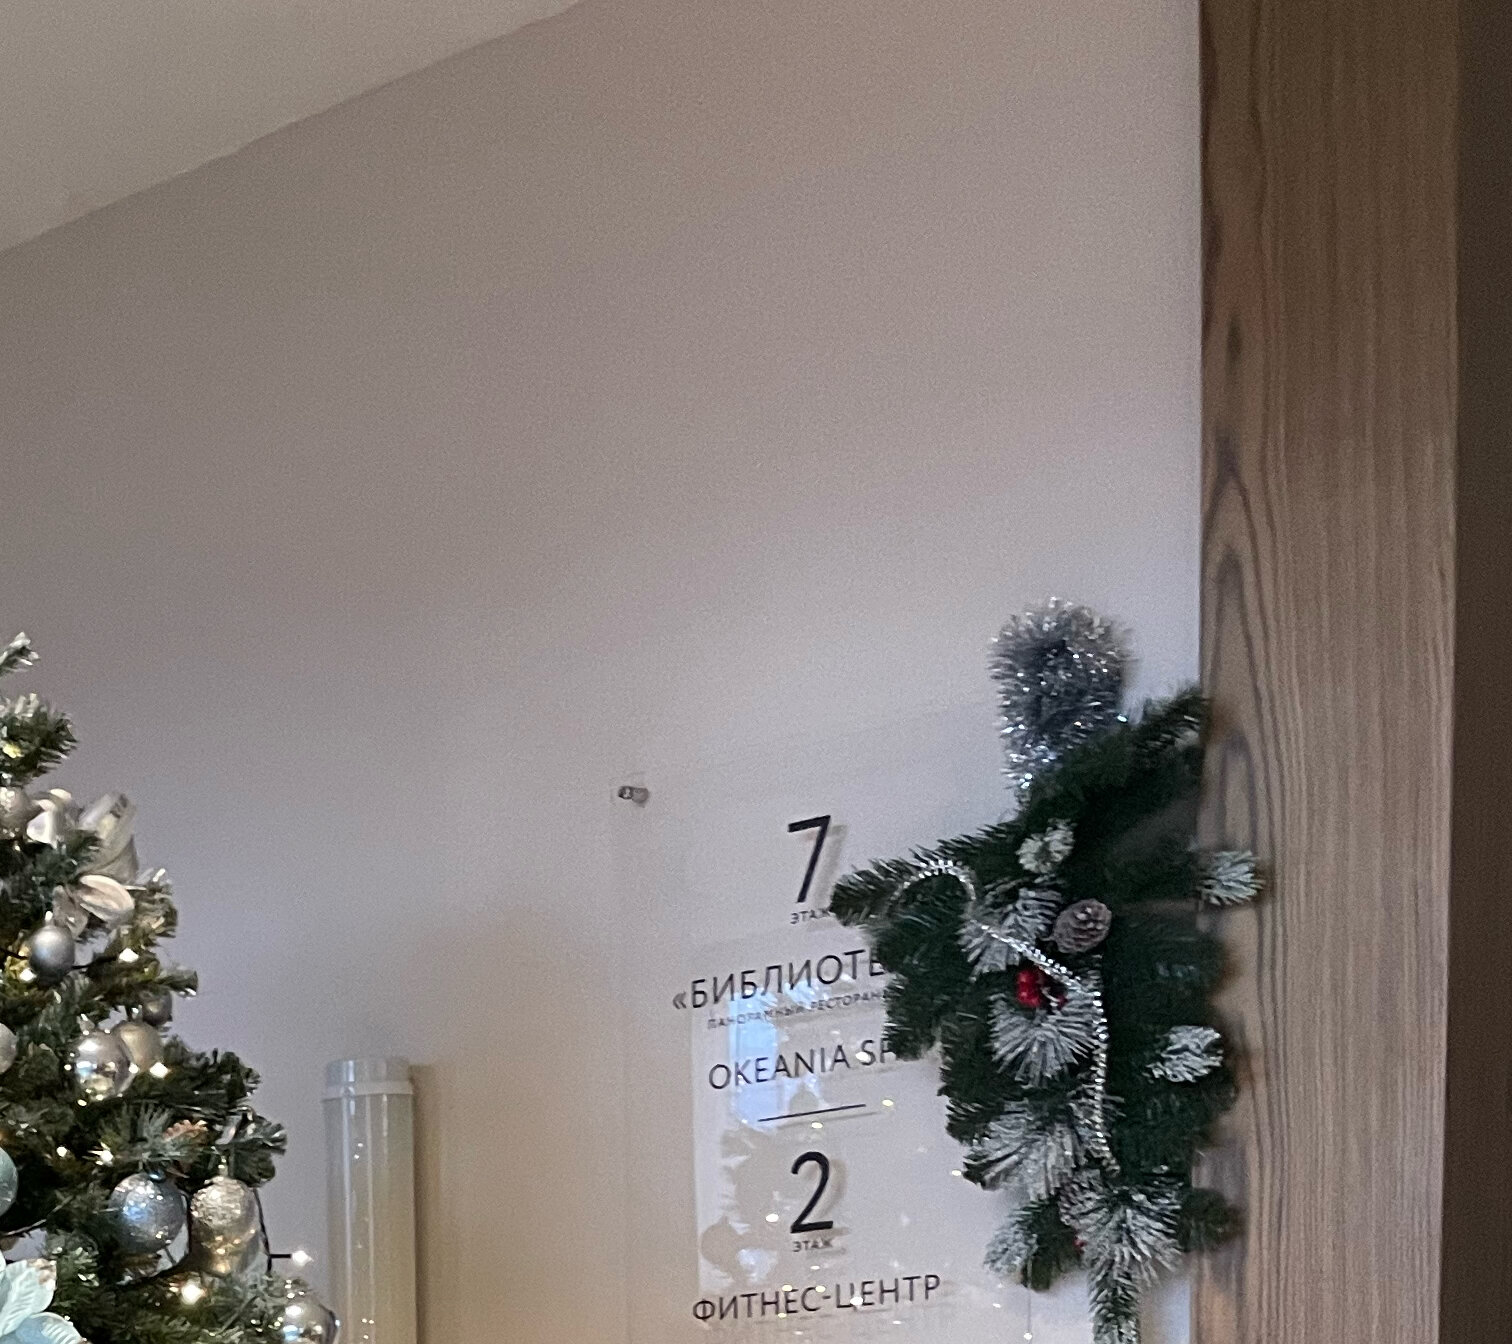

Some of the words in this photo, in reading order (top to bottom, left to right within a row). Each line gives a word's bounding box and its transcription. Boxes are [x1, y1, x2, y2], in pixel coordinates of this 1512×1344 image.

[787, 814, 832, 904] 7
[708, 1044, 851, 1090] OKEANIA
[790, 1151, 834, 1234] 2
[792, 1237, 834, 1253] ЭТАЖ
[691, 1274, 941, 1322] ФИТНЕС-ЦЕНТР
